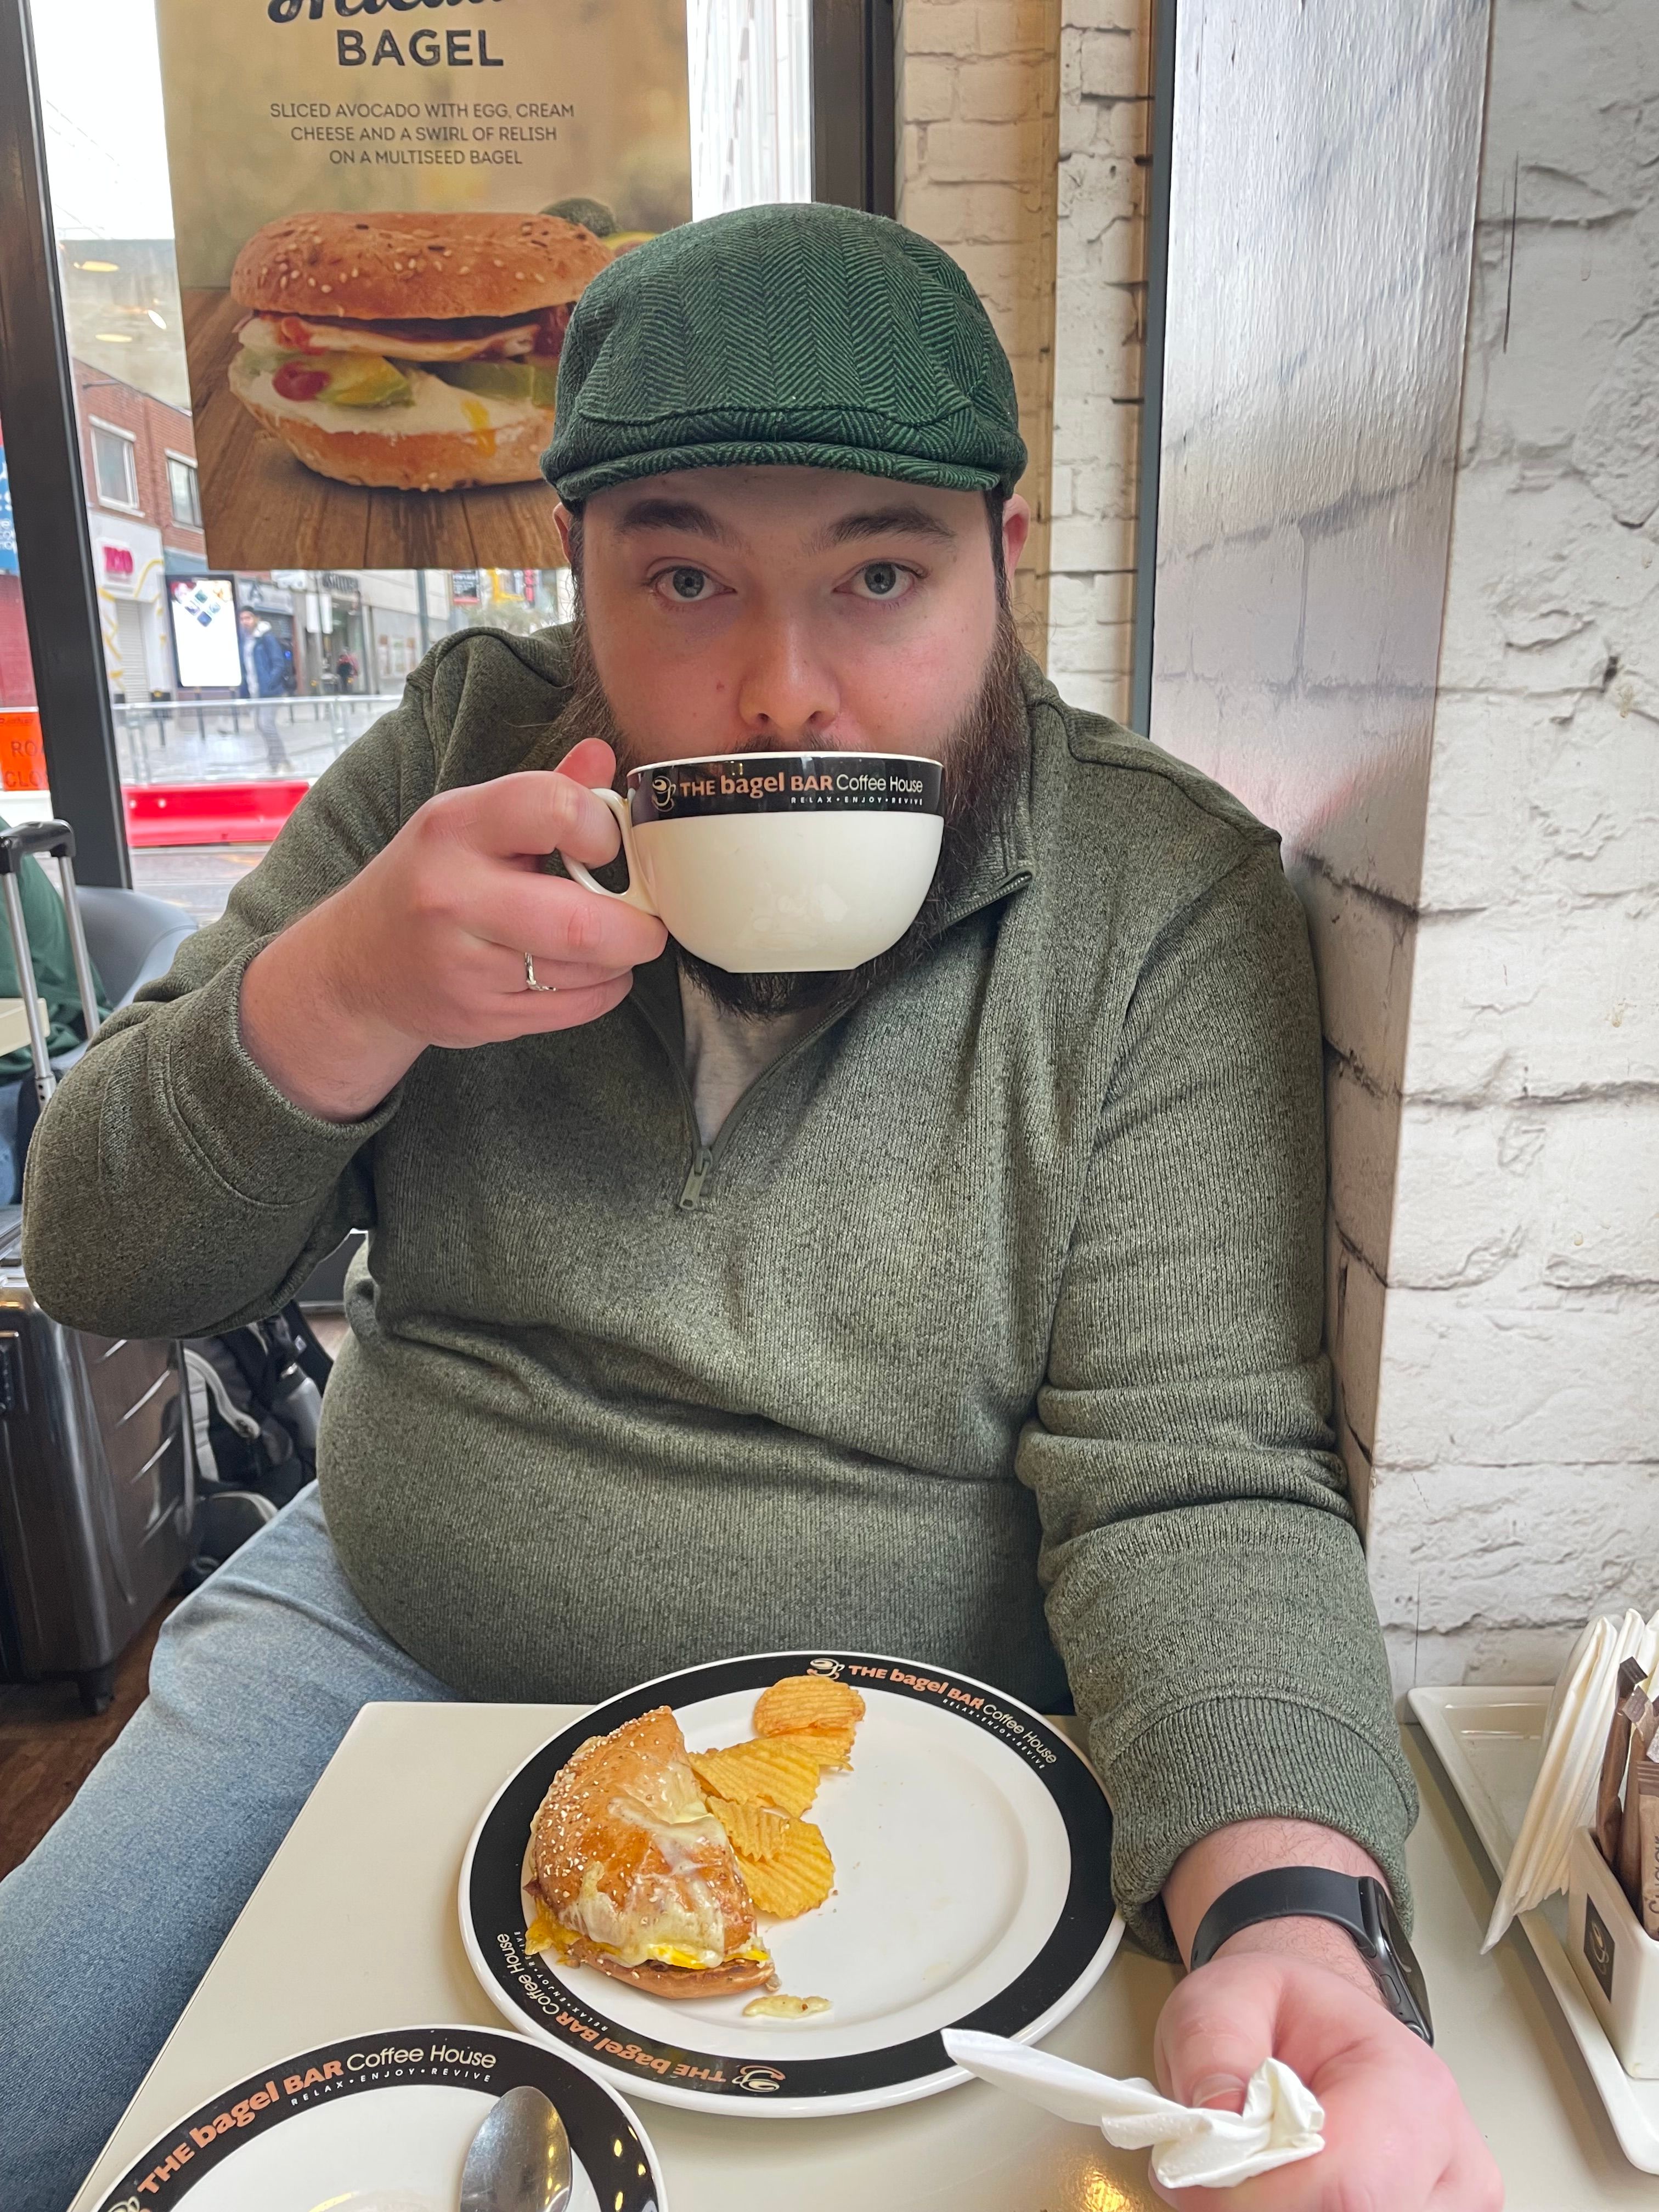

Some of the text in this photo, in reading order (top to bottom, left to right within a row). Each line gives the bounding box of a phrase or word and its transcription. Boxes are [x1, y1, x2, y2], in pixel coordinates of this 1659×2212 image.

[337, 29, 504, 66] BAGEL
[270, 103, 330, 117] SLICED
[335, 103, 420, 117] AVOCADO
[425, 103, 469, 117] WITH
[516, 103, 574, 117] CREAM
[291, 127, 557, 141] CHEESE AND A SWIRL OF RELISH
[329, 150, 522, 164] ON A MULTISEED BAGEL
[11, 740, 44, 757] RO
[5, 771, 45, 787] CLO
[680, 772, 923, 799] THE bagel BAR Coffee House
[849, 1665, 1057, 1763] THE bagel BAR Coffee House
[497, 1933, 726, 2083] THE bagel BAR Coffee House
[291, 2068, 491, 2106] RELAX ENJOY REVIVE
[137, 2045, 496, 2195] THE bagel BAR Coffee House
